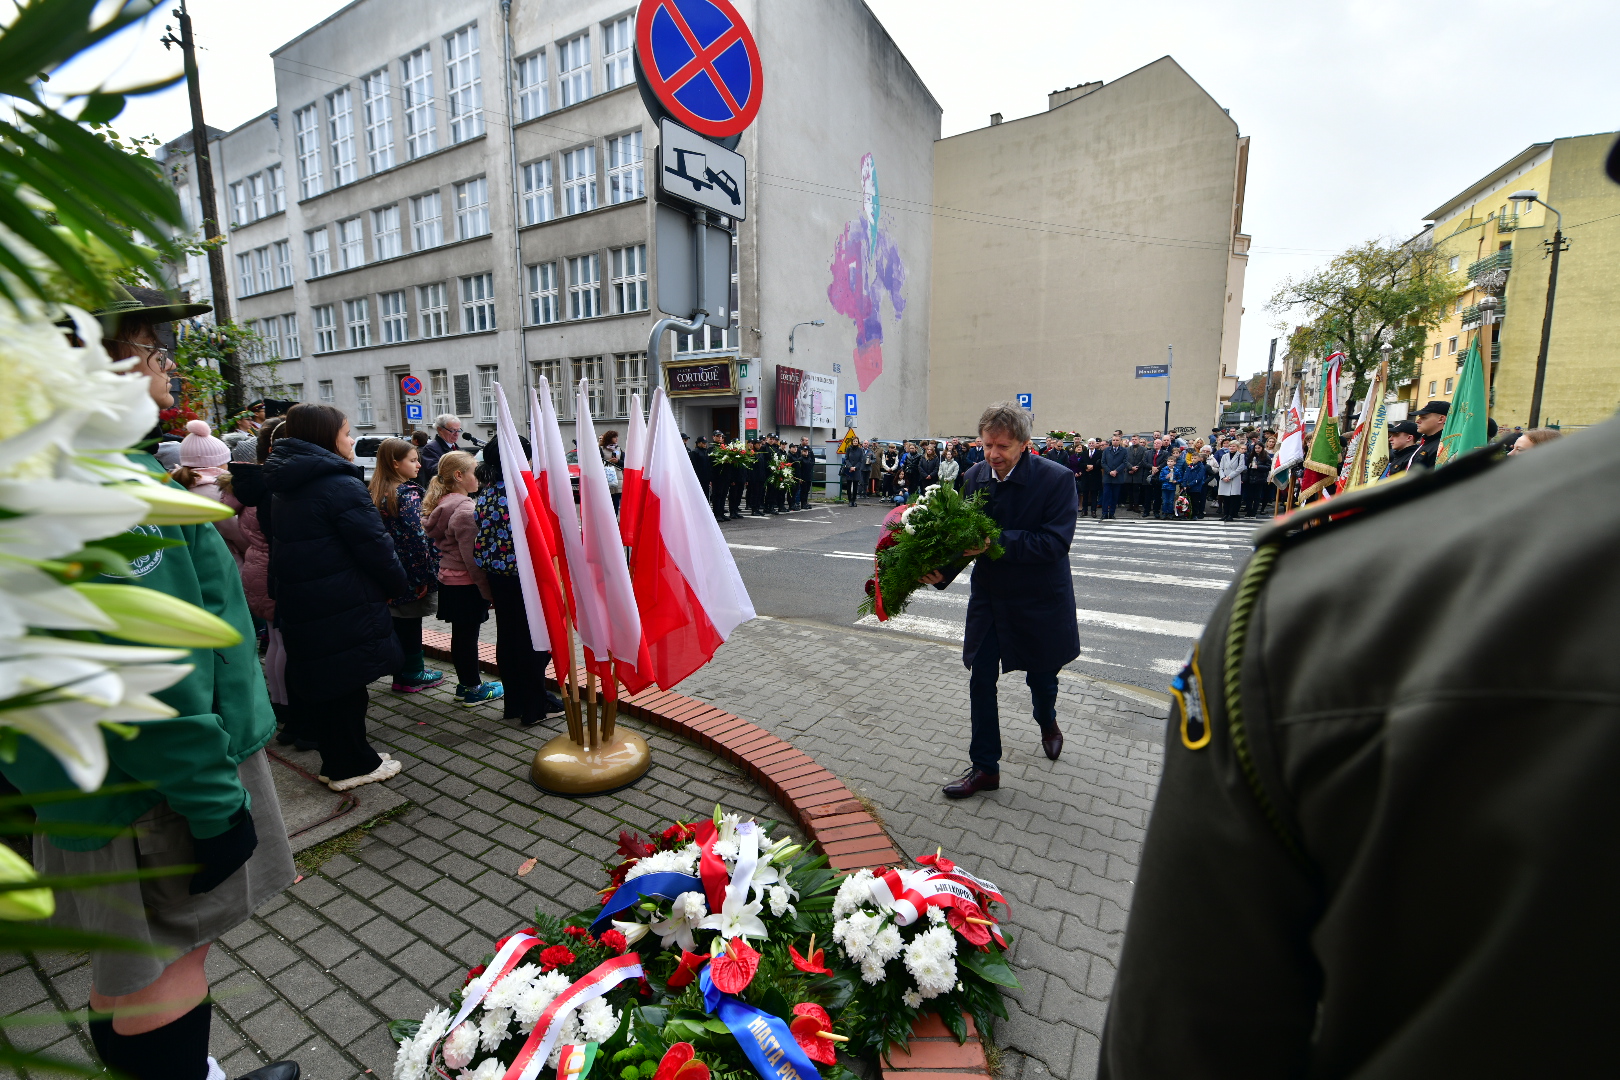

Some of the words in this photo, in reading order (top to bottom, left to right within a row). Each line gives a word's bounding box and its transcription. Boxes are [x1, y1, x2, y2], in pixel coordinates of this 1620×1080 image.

[740, 365, 747, 377] A
[847, 395, 855, 414] P
[1019, 394, 1029, 408] P
[410, 405, 420, 418] P
[747, 1015, 785, 1068] MIASTA
